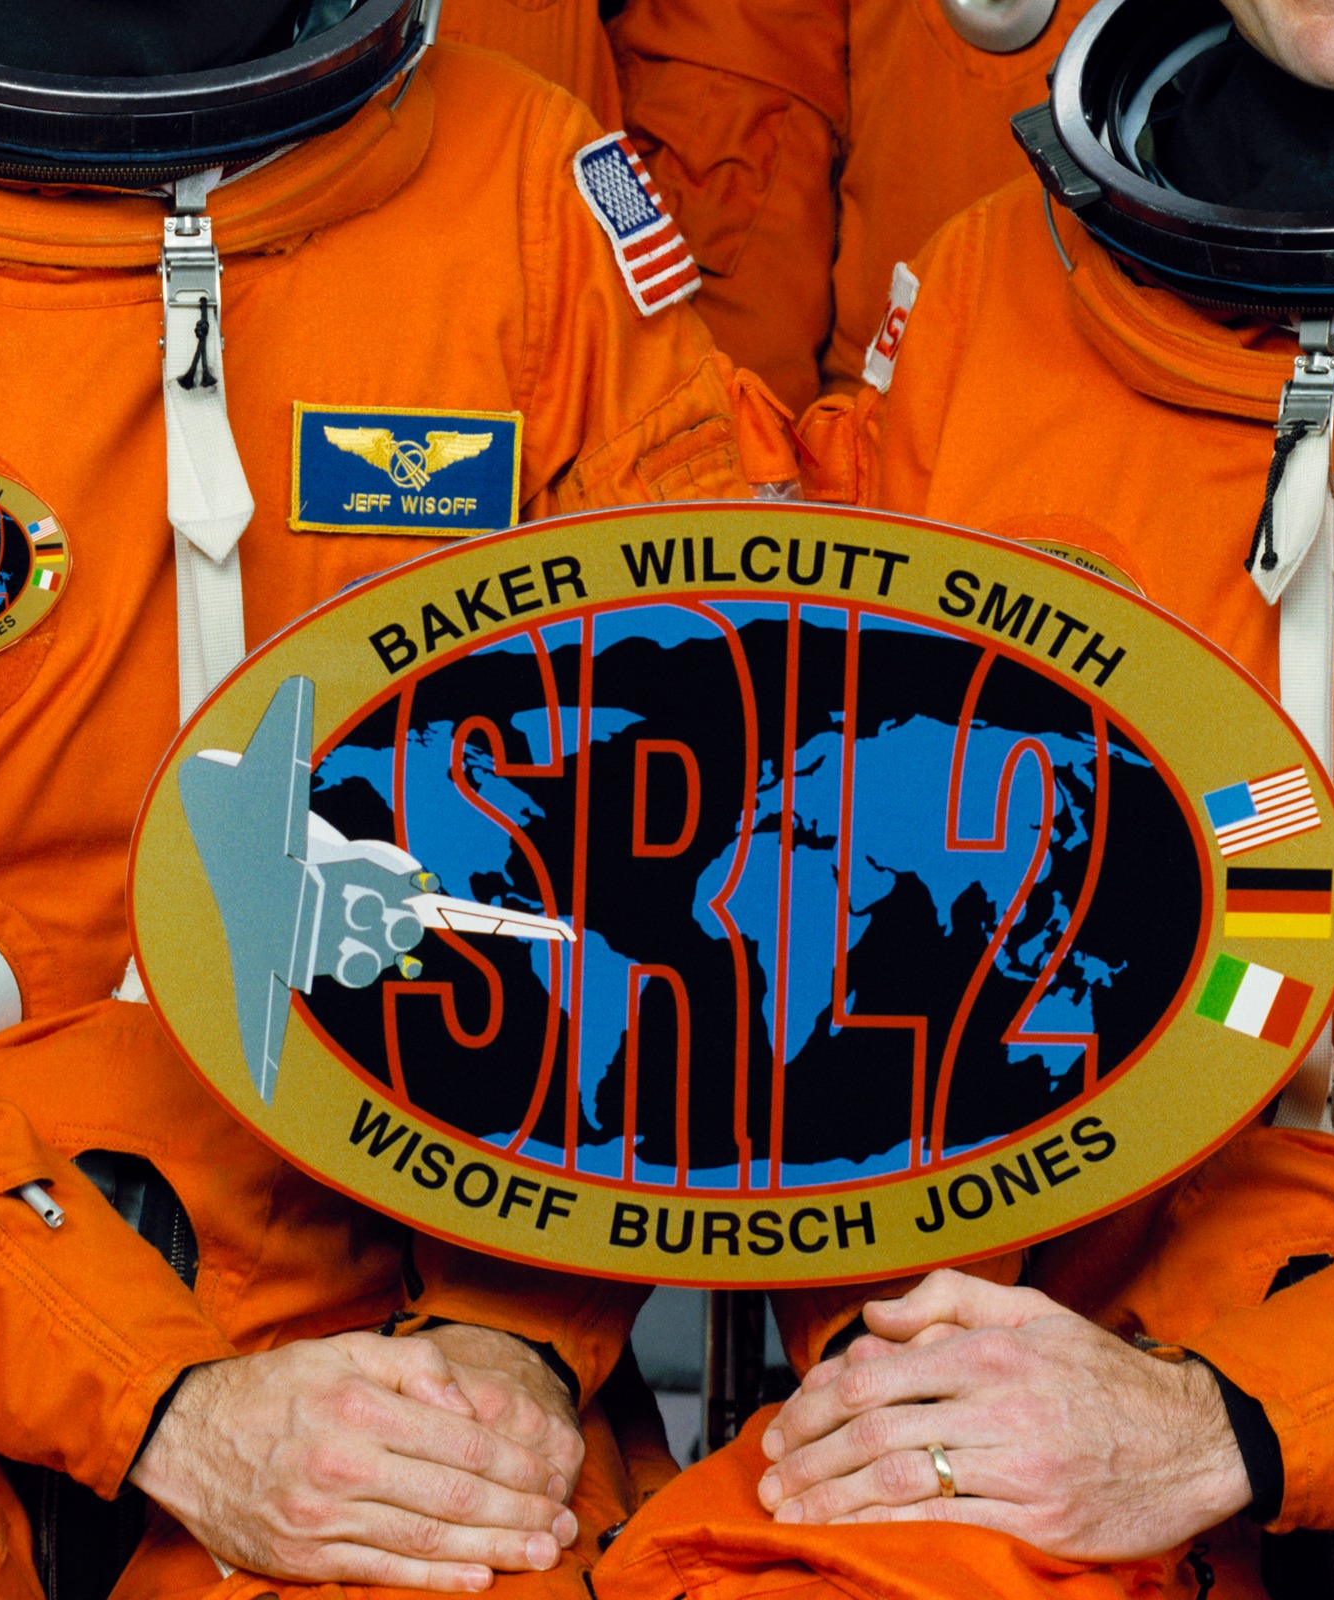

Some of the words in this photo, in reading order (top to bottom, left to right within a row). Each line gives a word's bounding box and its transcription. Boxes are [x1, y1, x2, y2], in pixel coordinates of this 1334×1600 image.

[343, 492, 391, 513] JEFF
[401, 495, 477, 516] WISOFF
[368, 555, 589, 676] BAKER
[620, 536, 910, 598] WILCUTT
[937, 569, 1128, 689] SMITH
[383, 595, 1109, 1191] SRL2
[346, 1098, 579, 1232] WISOFF
[609, 1200, 875, 1258] BURSCH
[915, 1115, 1118, 1239] JONES
